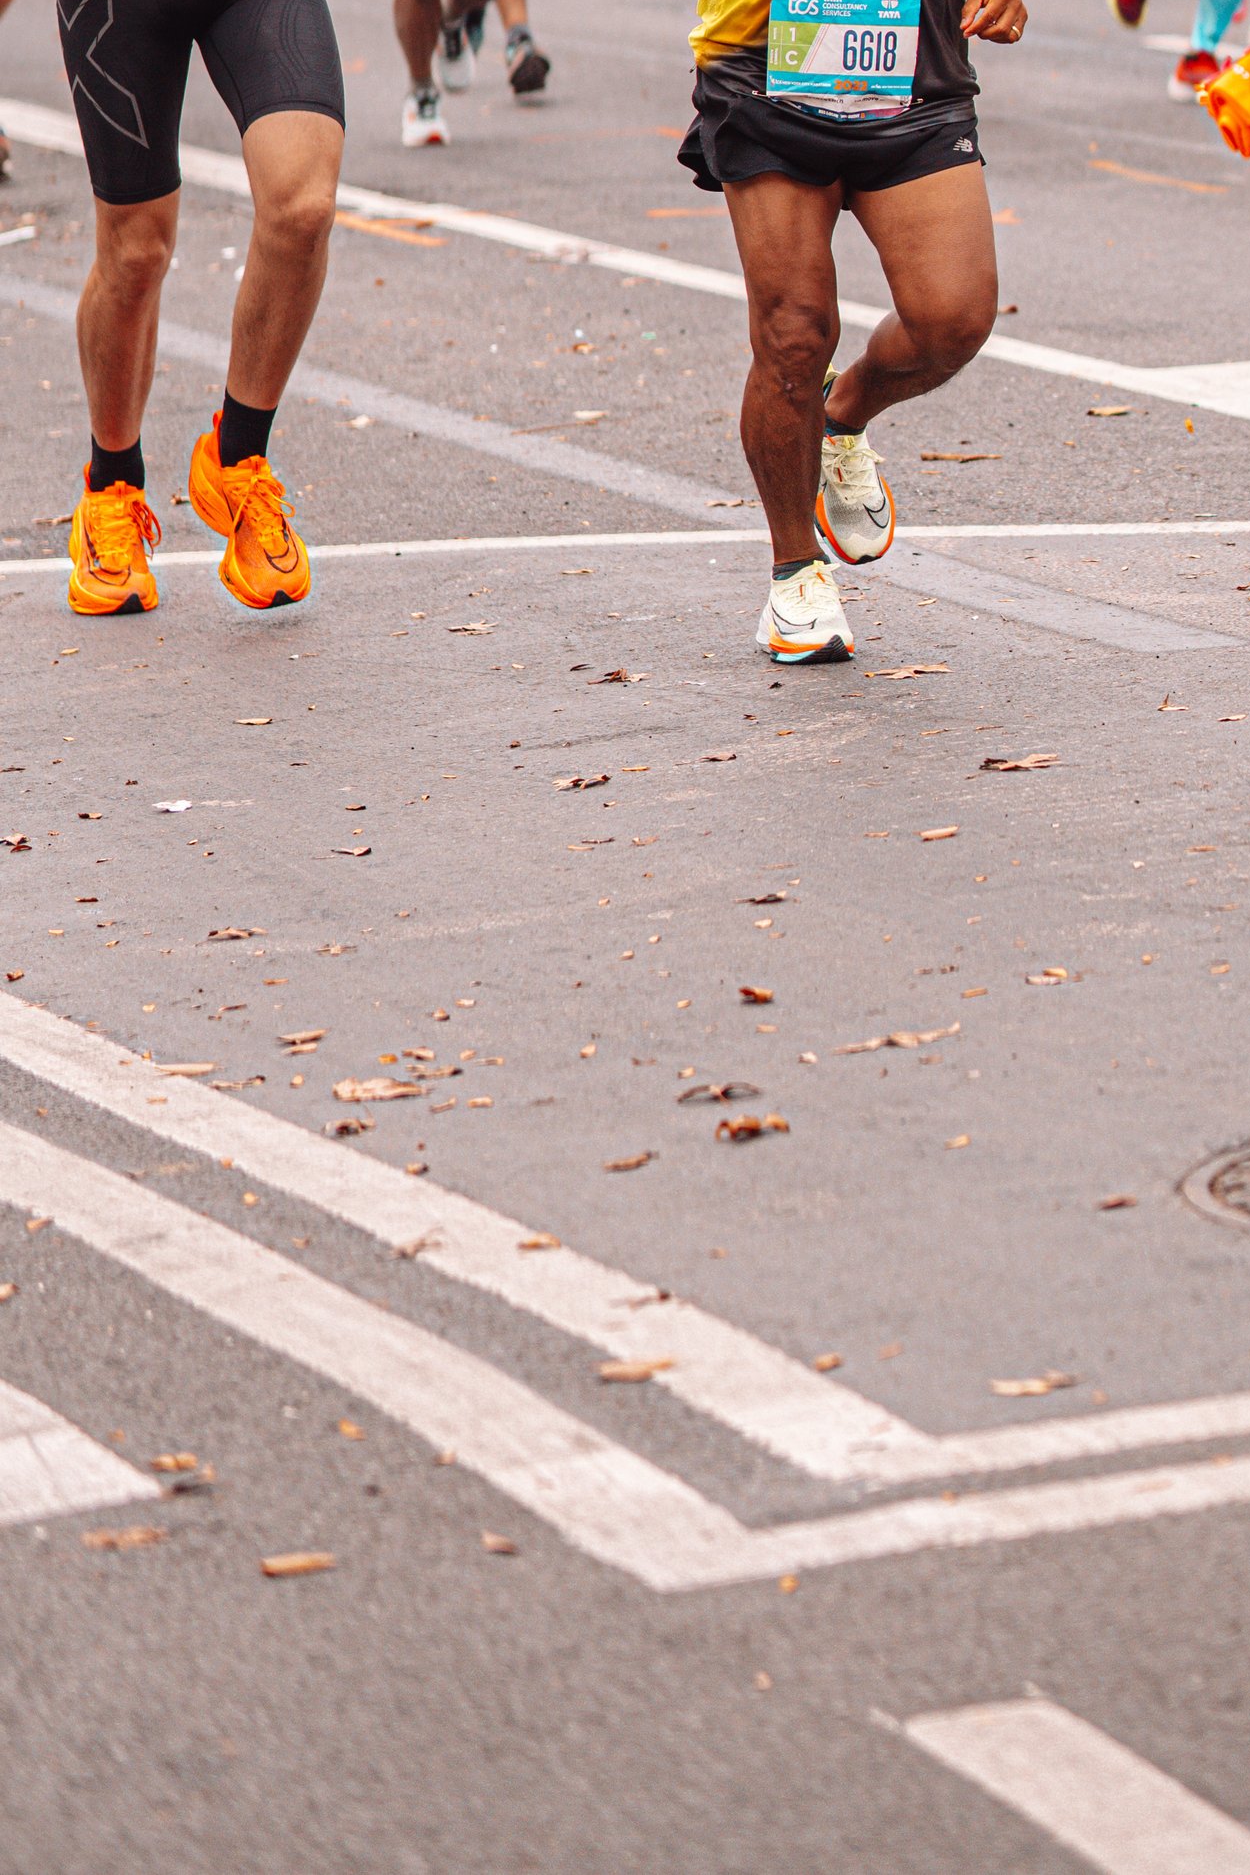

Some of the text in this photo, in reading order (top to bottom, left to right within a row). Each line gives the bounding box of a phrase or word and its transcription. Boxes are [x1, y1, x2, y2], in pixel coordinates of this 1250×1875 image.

[822, 3, 868, 11] CONSULTANCY
[878, 10, 901, 19] TATA
[789, 27, 797, 42] 1
[842, 29, 898, 72] 6618
[785, 50, 798, 65] C
[833, 79, 868, 91] 2022
